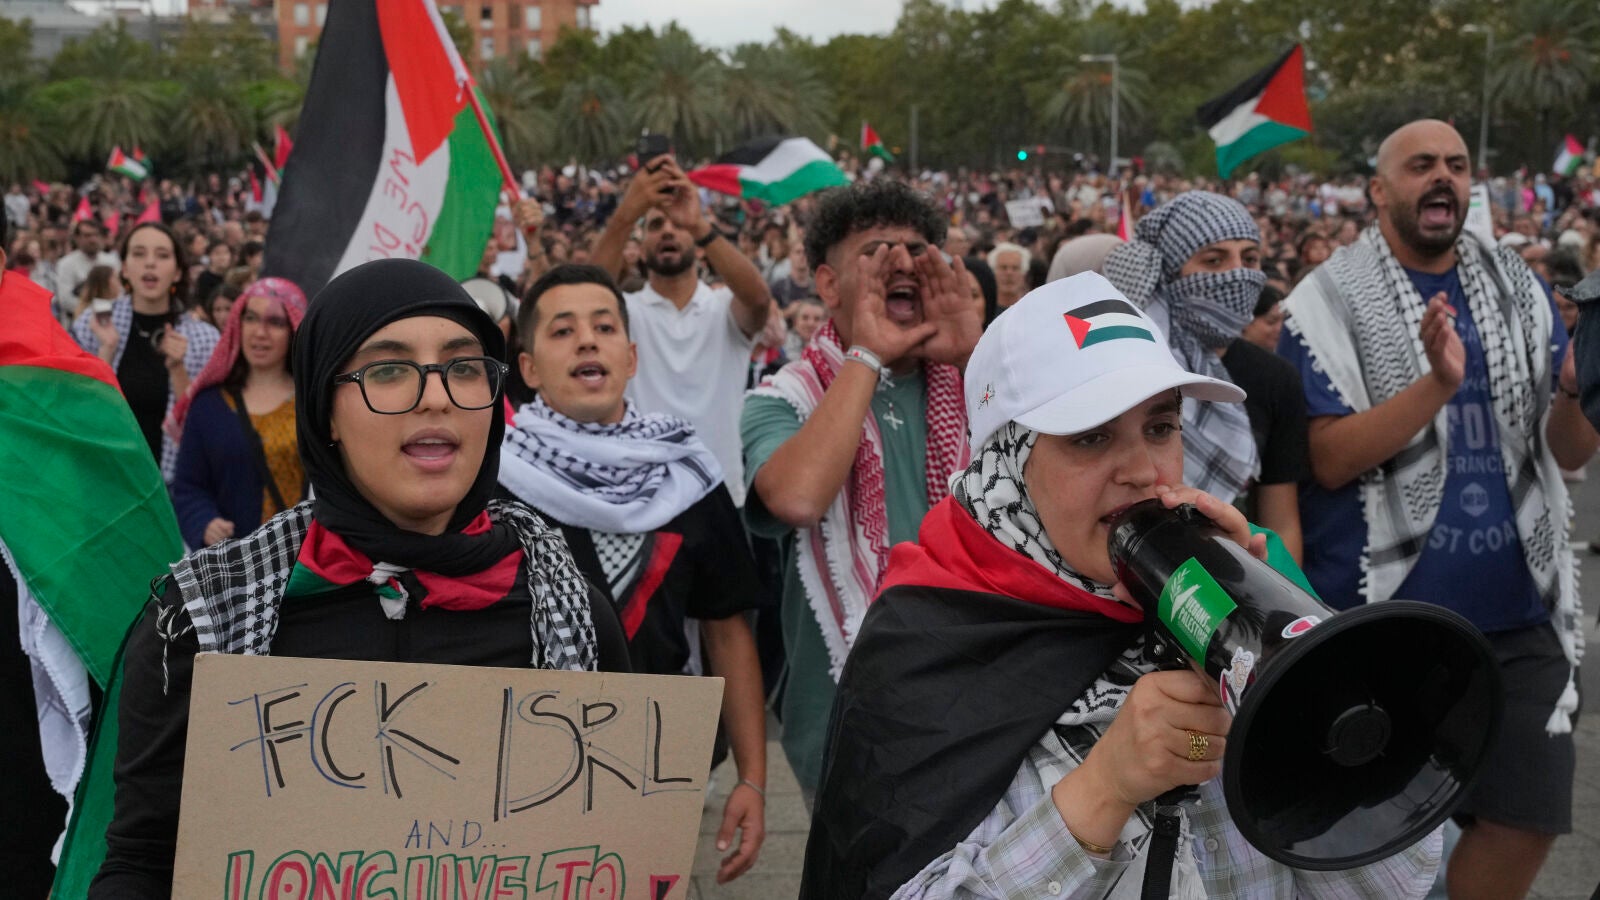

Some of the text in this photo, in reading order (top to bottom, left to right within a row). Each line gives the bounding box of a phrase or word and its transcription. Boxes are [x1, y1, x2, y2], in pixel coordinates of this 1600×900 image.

[1468, 519, 1516, 555] COA
[228, 681, 702, 822] FCK ISRL
